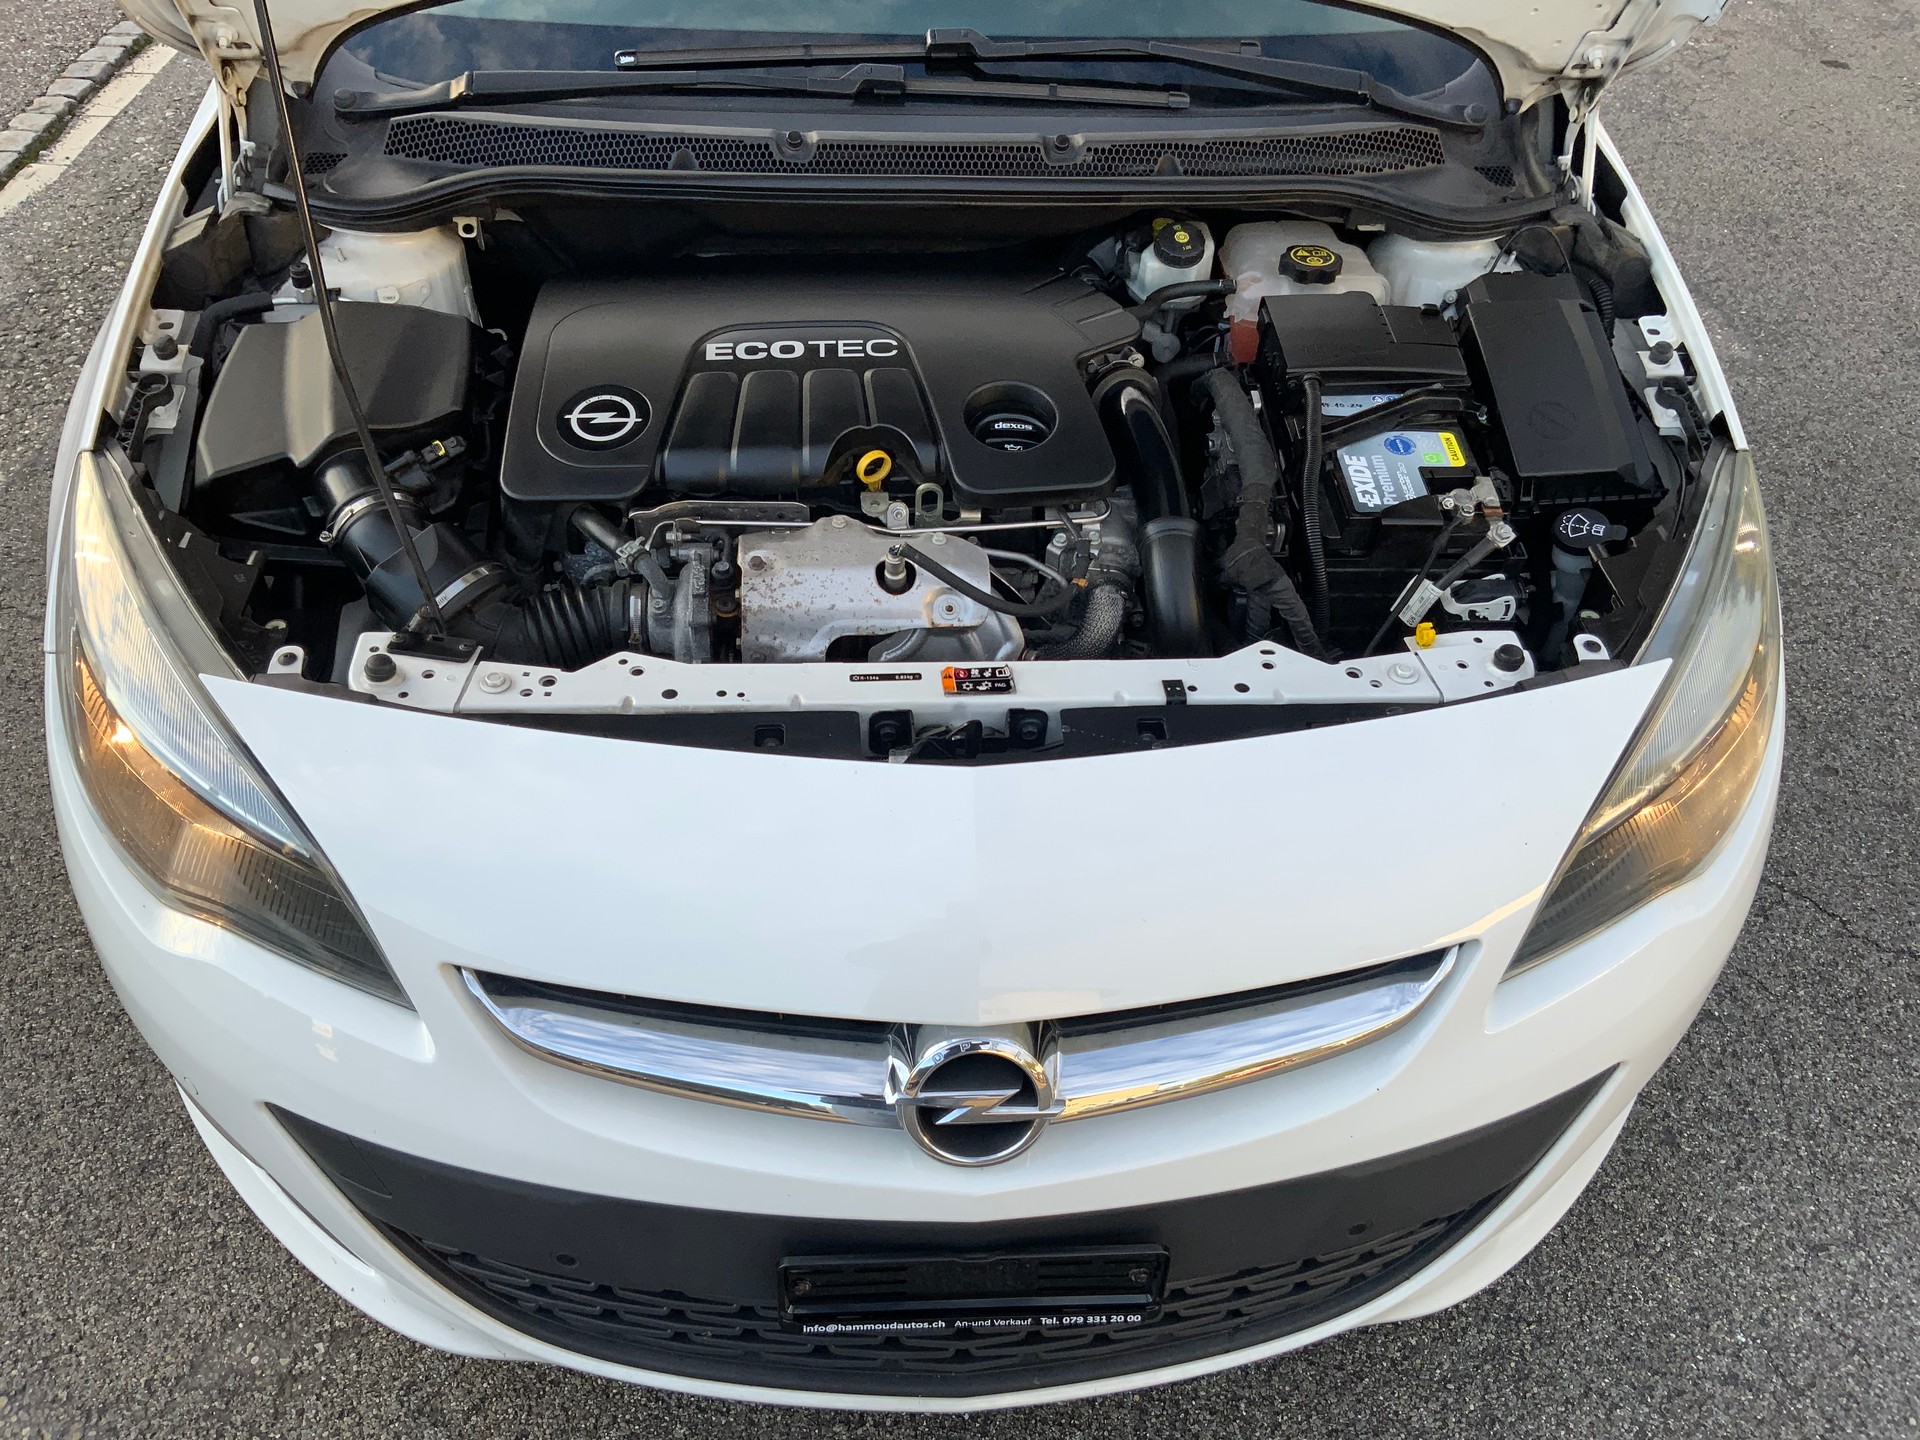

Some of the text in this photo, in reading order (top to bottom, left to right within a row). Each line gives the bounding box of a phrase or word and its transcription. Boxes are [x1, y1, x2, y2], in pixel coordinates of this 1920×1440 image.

[705, 338, 899, 361] ECOTEC
[994, 421, 1033, 431] dexos
[1443, 437, 1459, 461] CAUTION
[1343, 454, 1381, 508] EXIDE
[1371, 455, 1396, 505] Premium
[932, 1041, 1024, 1065] OPEL
[803, 1314, 1142, 1333] info@hammoudautos.ch An-und Verkauf Tel. 079 331 20 00
